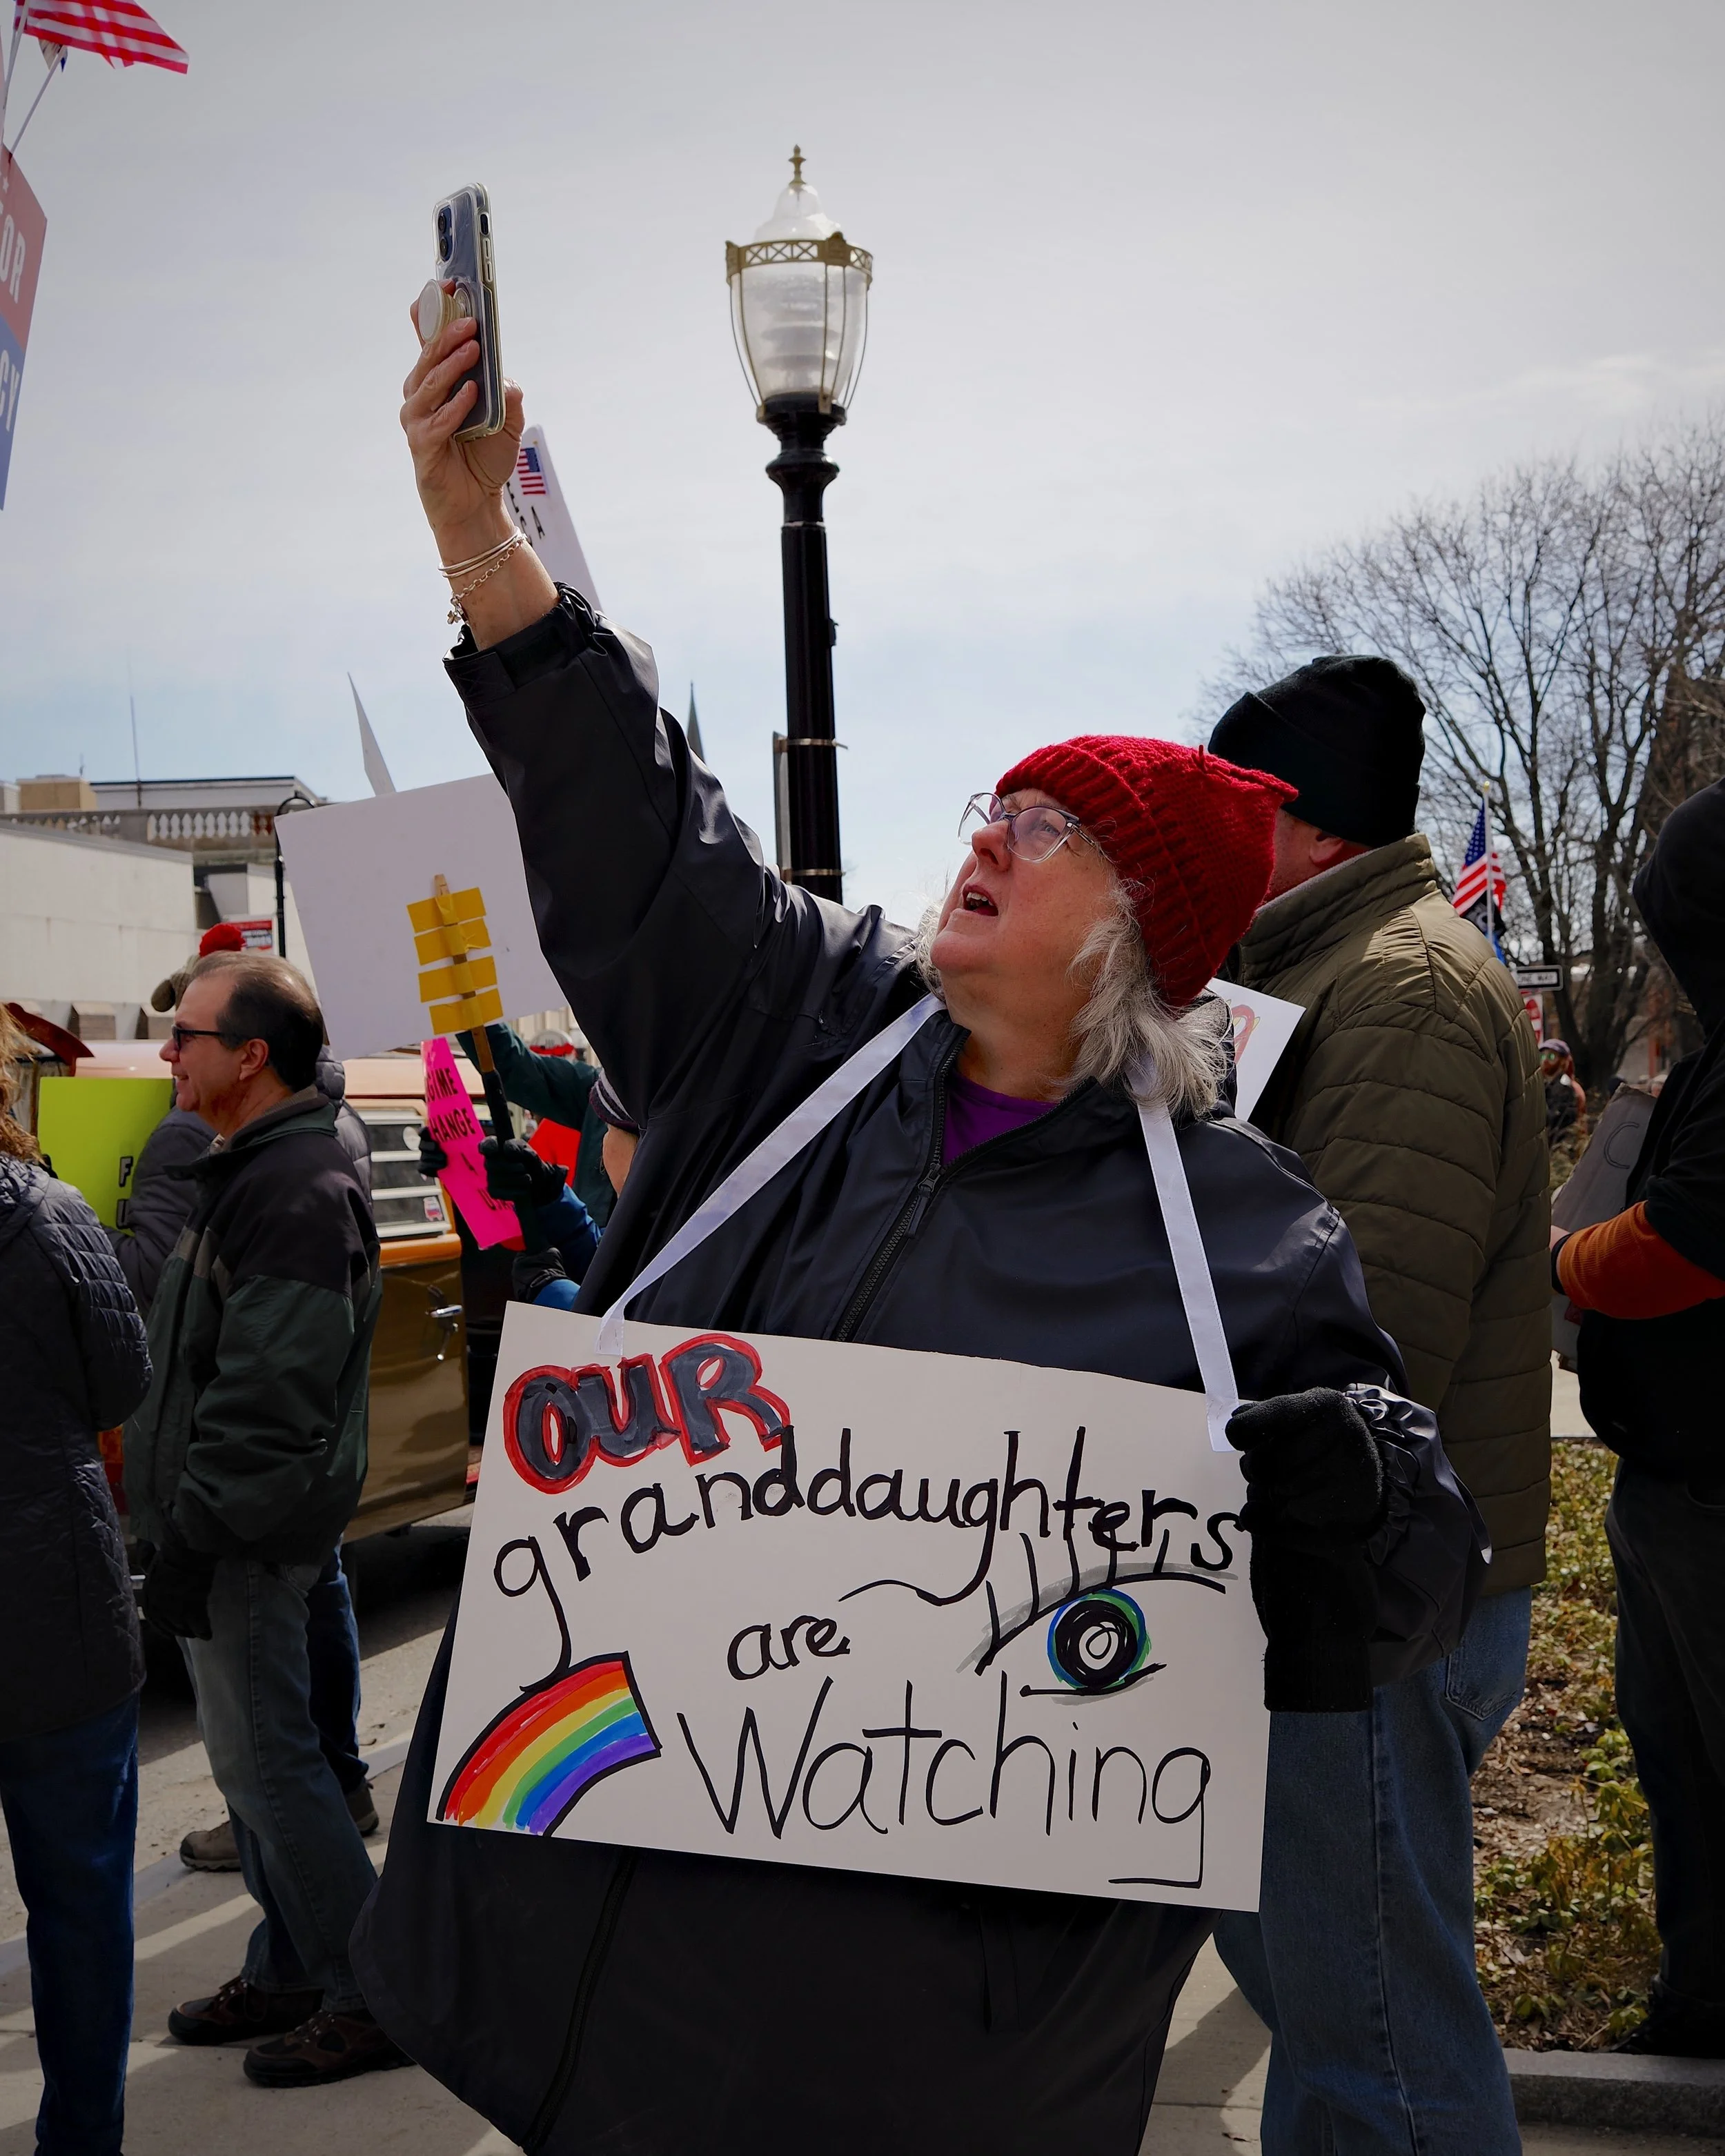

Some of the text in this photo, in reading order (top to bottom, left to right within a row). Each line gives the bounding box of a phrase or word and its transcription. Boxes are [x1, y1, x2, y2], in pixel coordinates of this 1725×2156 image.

[0, 202, 26, 304] OR
[426, 1067, 458, 1102] GIME
[429, 1108, 475, 1143] HANGE
[503, 1333, 791, 1494] OUR
[494, 1425, 1245, 1692] granddaughters
[727, 1614, 851, 1681] are
[676, 1671, 1212, 1890] Watching
